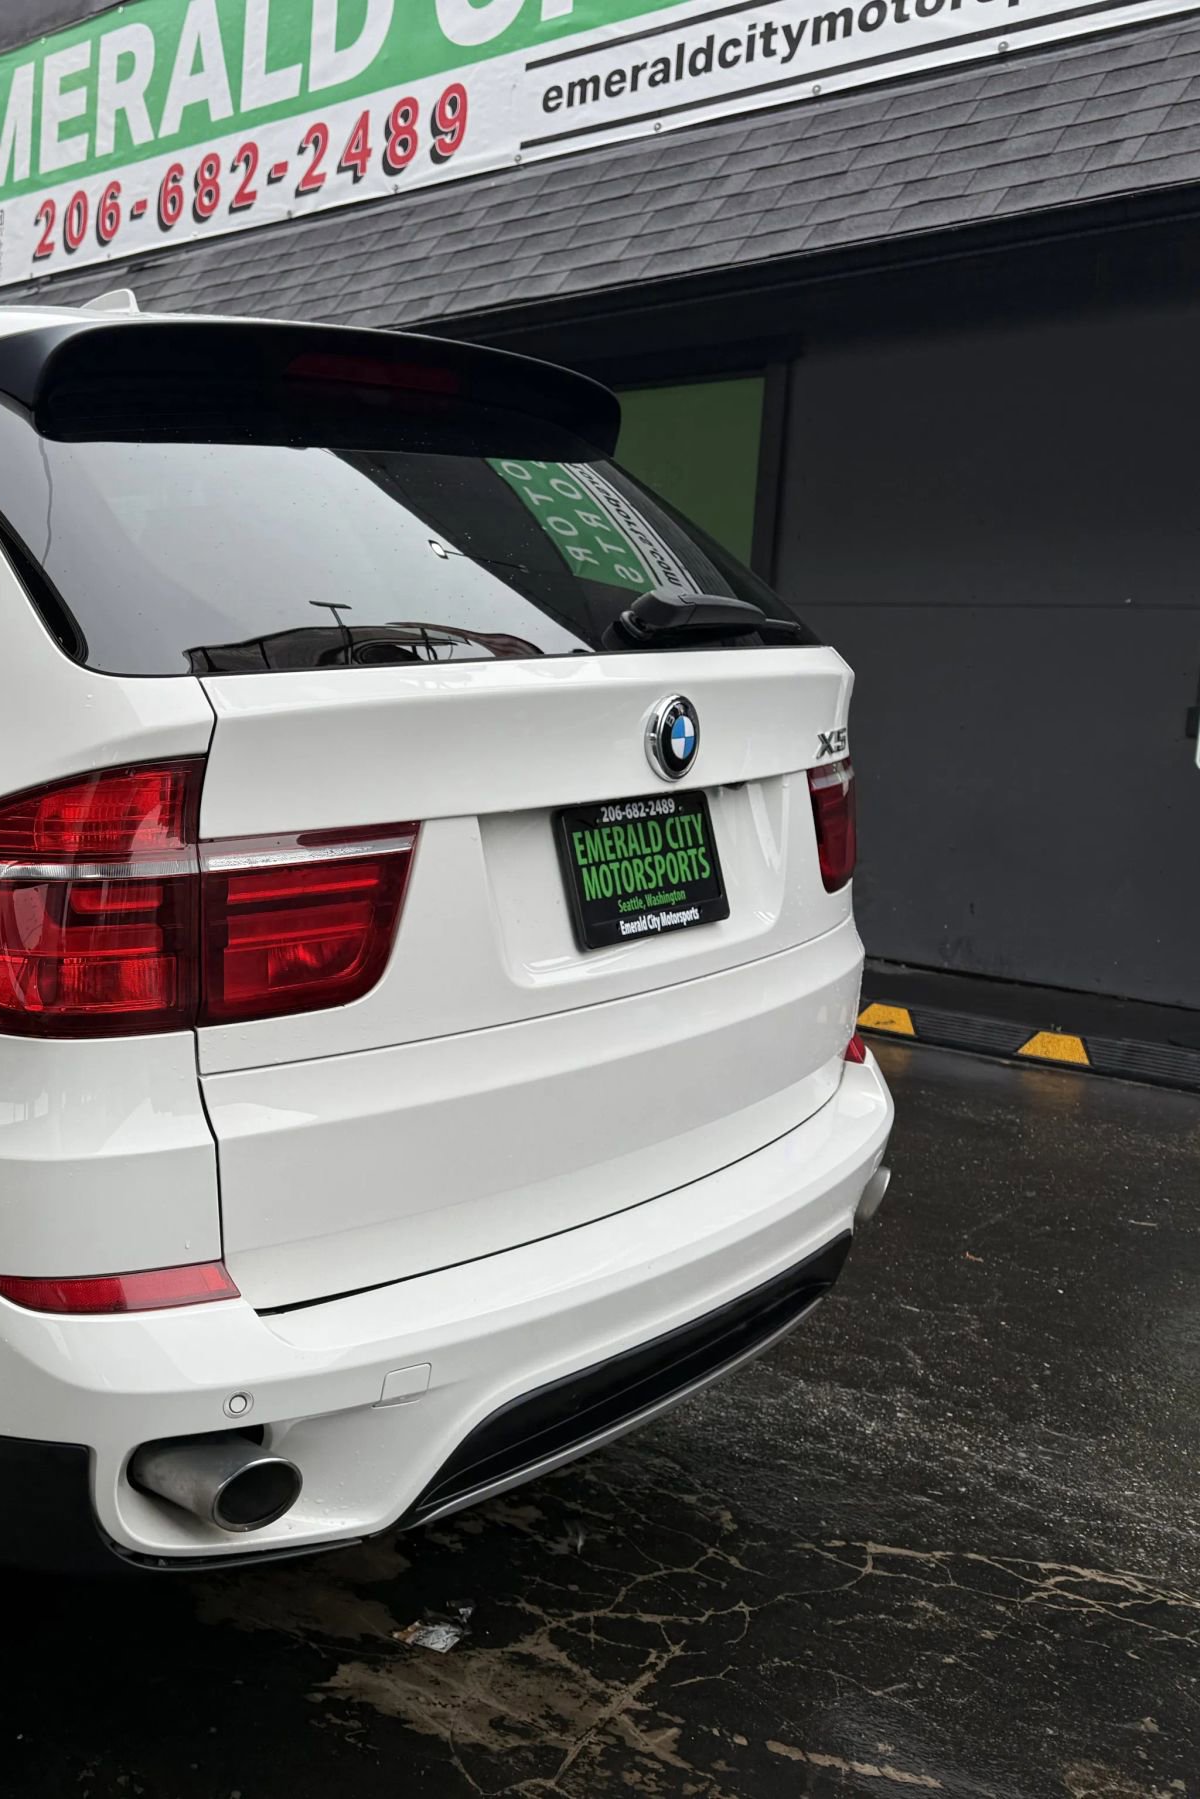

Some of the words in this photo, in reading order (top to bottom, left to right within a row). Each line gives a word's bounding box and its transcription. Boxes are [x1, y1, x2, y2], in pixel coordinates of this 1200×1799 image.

[32, 82, 468, 262] 206-682-2489
[816, 727, 846, 760] X5
[600, 798, 675, 823] 206-682-2489
[572, 820, 662, 866] EMERALD
[665, 813, 704, 850] CITY
[582, 847, 710, 901] MOTORSPORTS
[618, 896, 646, 913] Seattle,
[645, 890, 686, 908] Washington
[619, 915, 648, 935] Emerald
[648, 912, 662, 931] City
[661, 907, 700, 927] Motorsports
